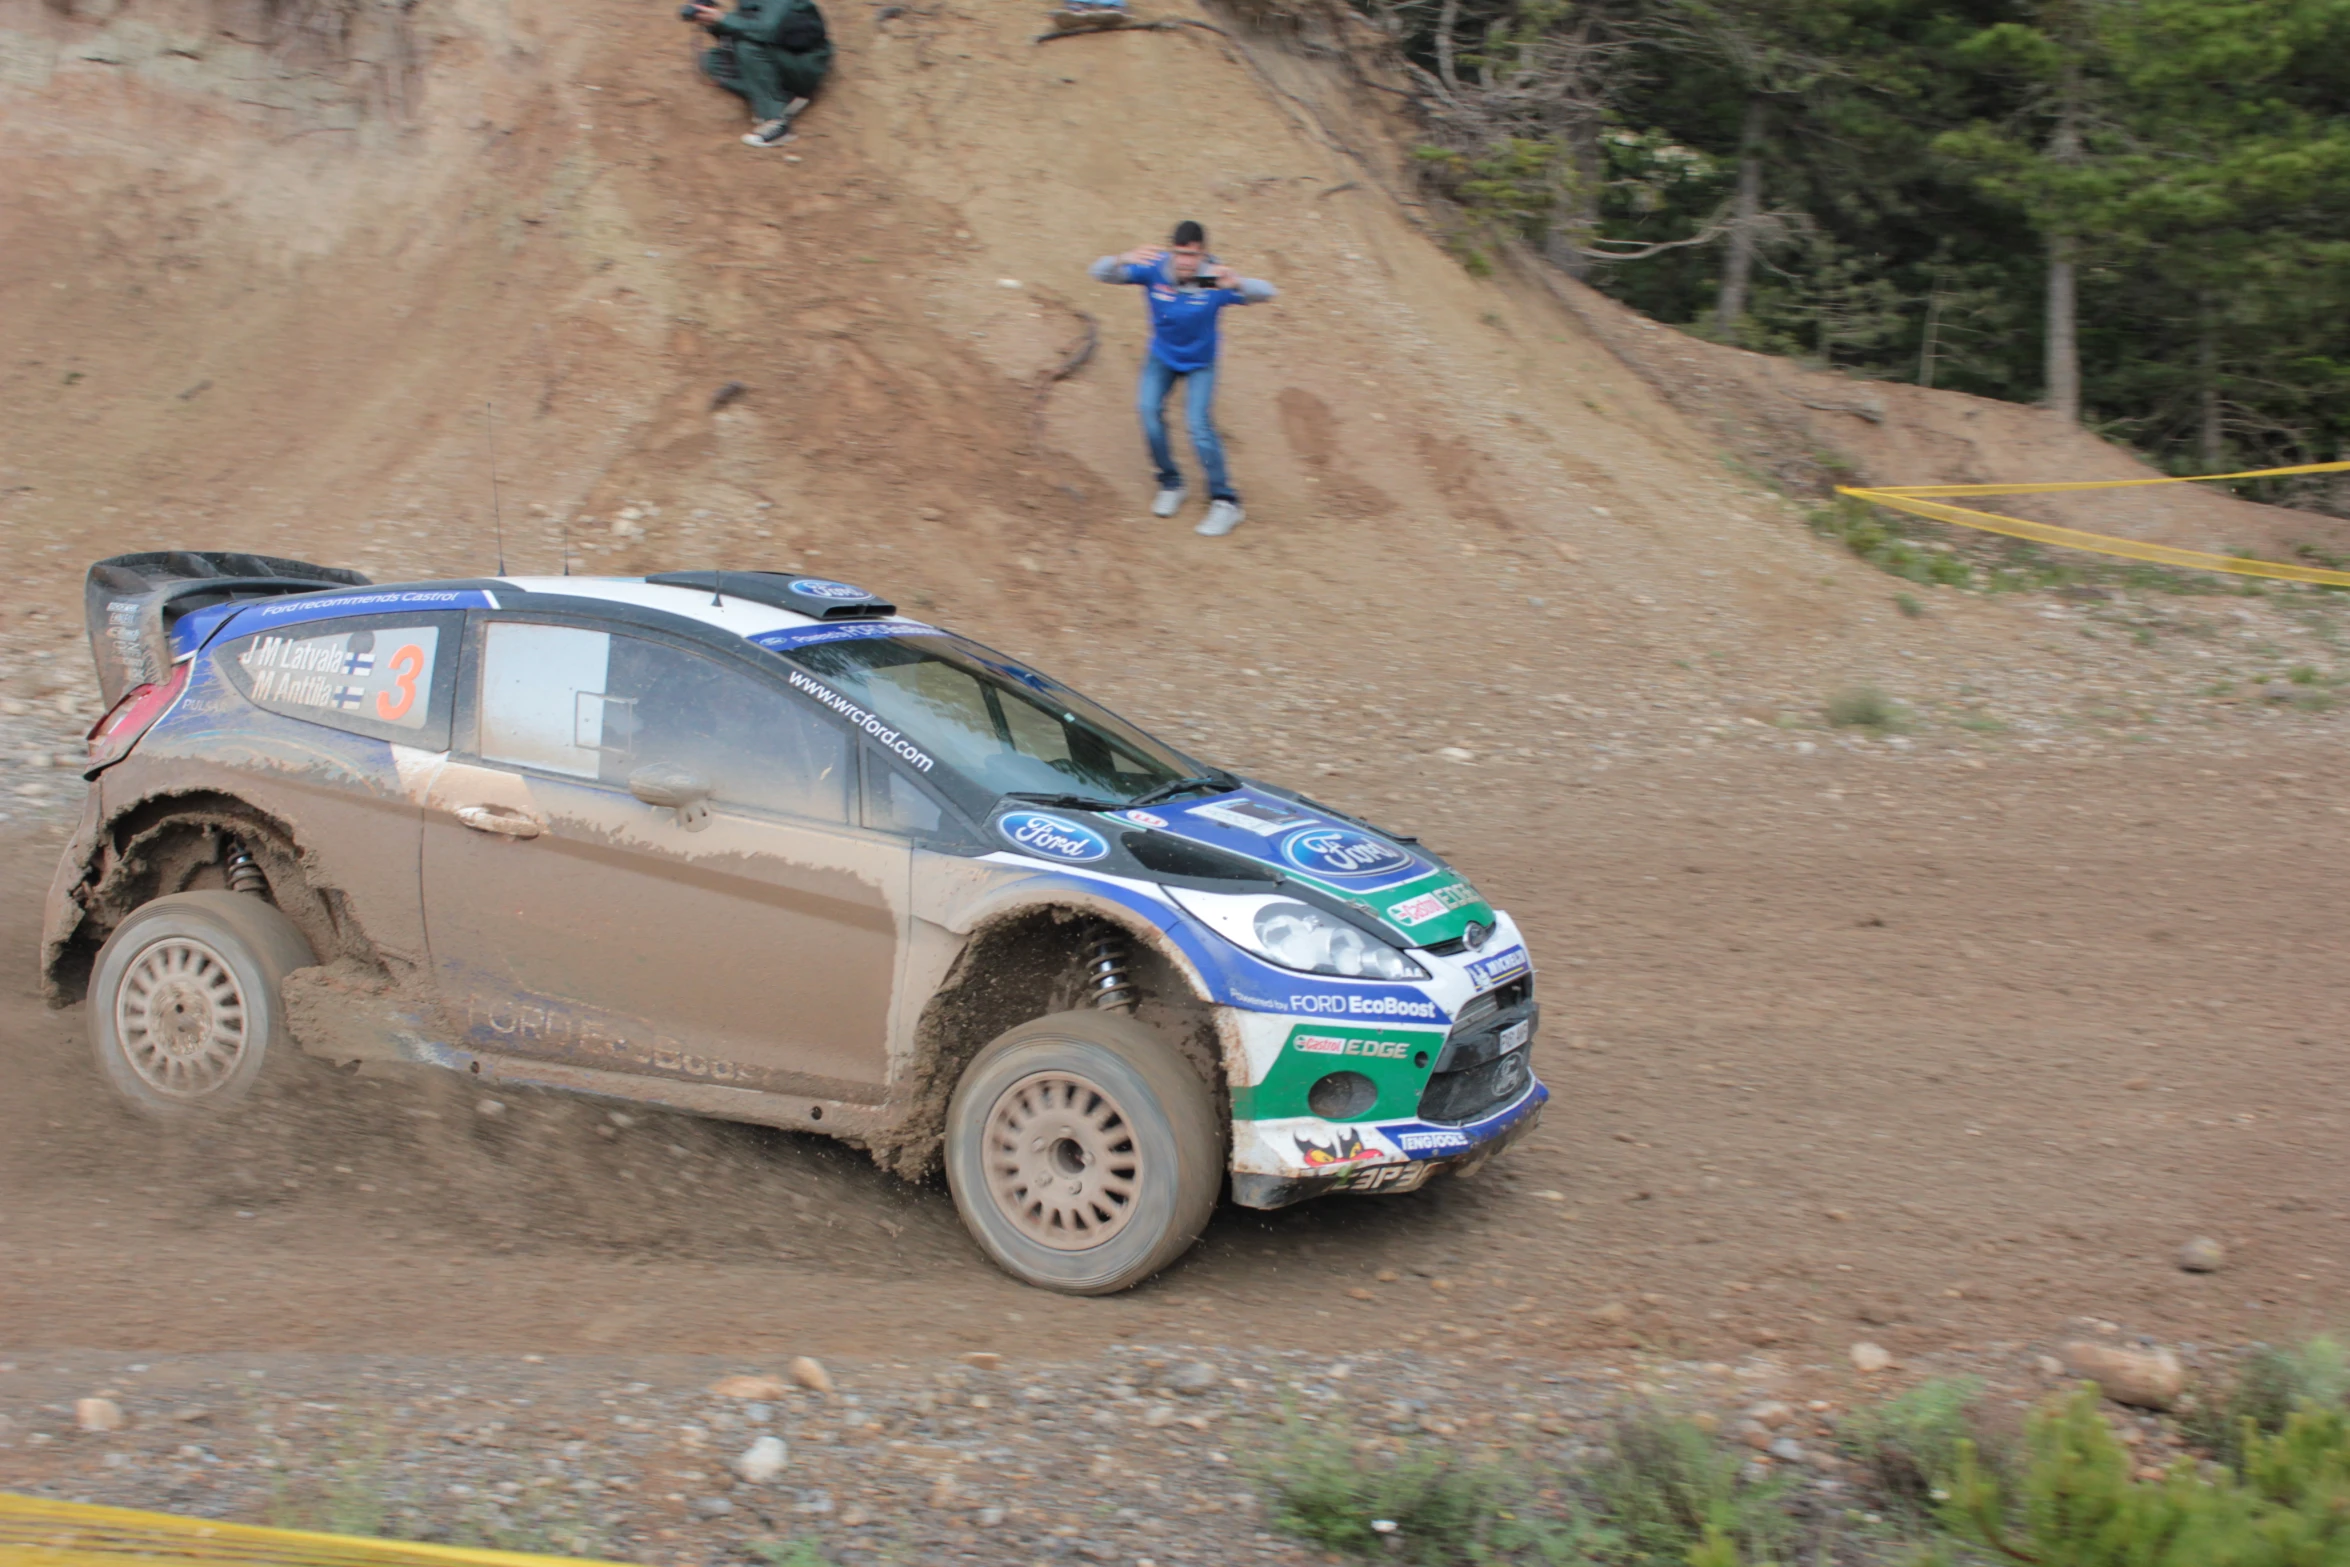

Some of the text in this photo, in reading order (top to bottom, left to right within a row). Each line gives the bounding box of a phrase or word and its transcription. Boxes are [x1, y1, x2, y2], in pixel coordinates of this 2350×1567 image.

[262, 592, 460, 617] Ford recommends Castrol
[804, 581, 866, 598] Ford
[241, 635, 343, 673] J M Latvala
[251, 670, 333, 707] M Anttila
[376, 643, 425, 721] 3
[788, 670, 934, 772] www.wrcford.com
[1015, 815, 1090, 857] Ford
[1302, 833, 1399, 870] Ford
[1290, 994, 1347, 1013] FORD
[1347, 995, 1436, 1018] EcoBoost
[1305, 1037, 1411, 1059] Castrol EDGE
